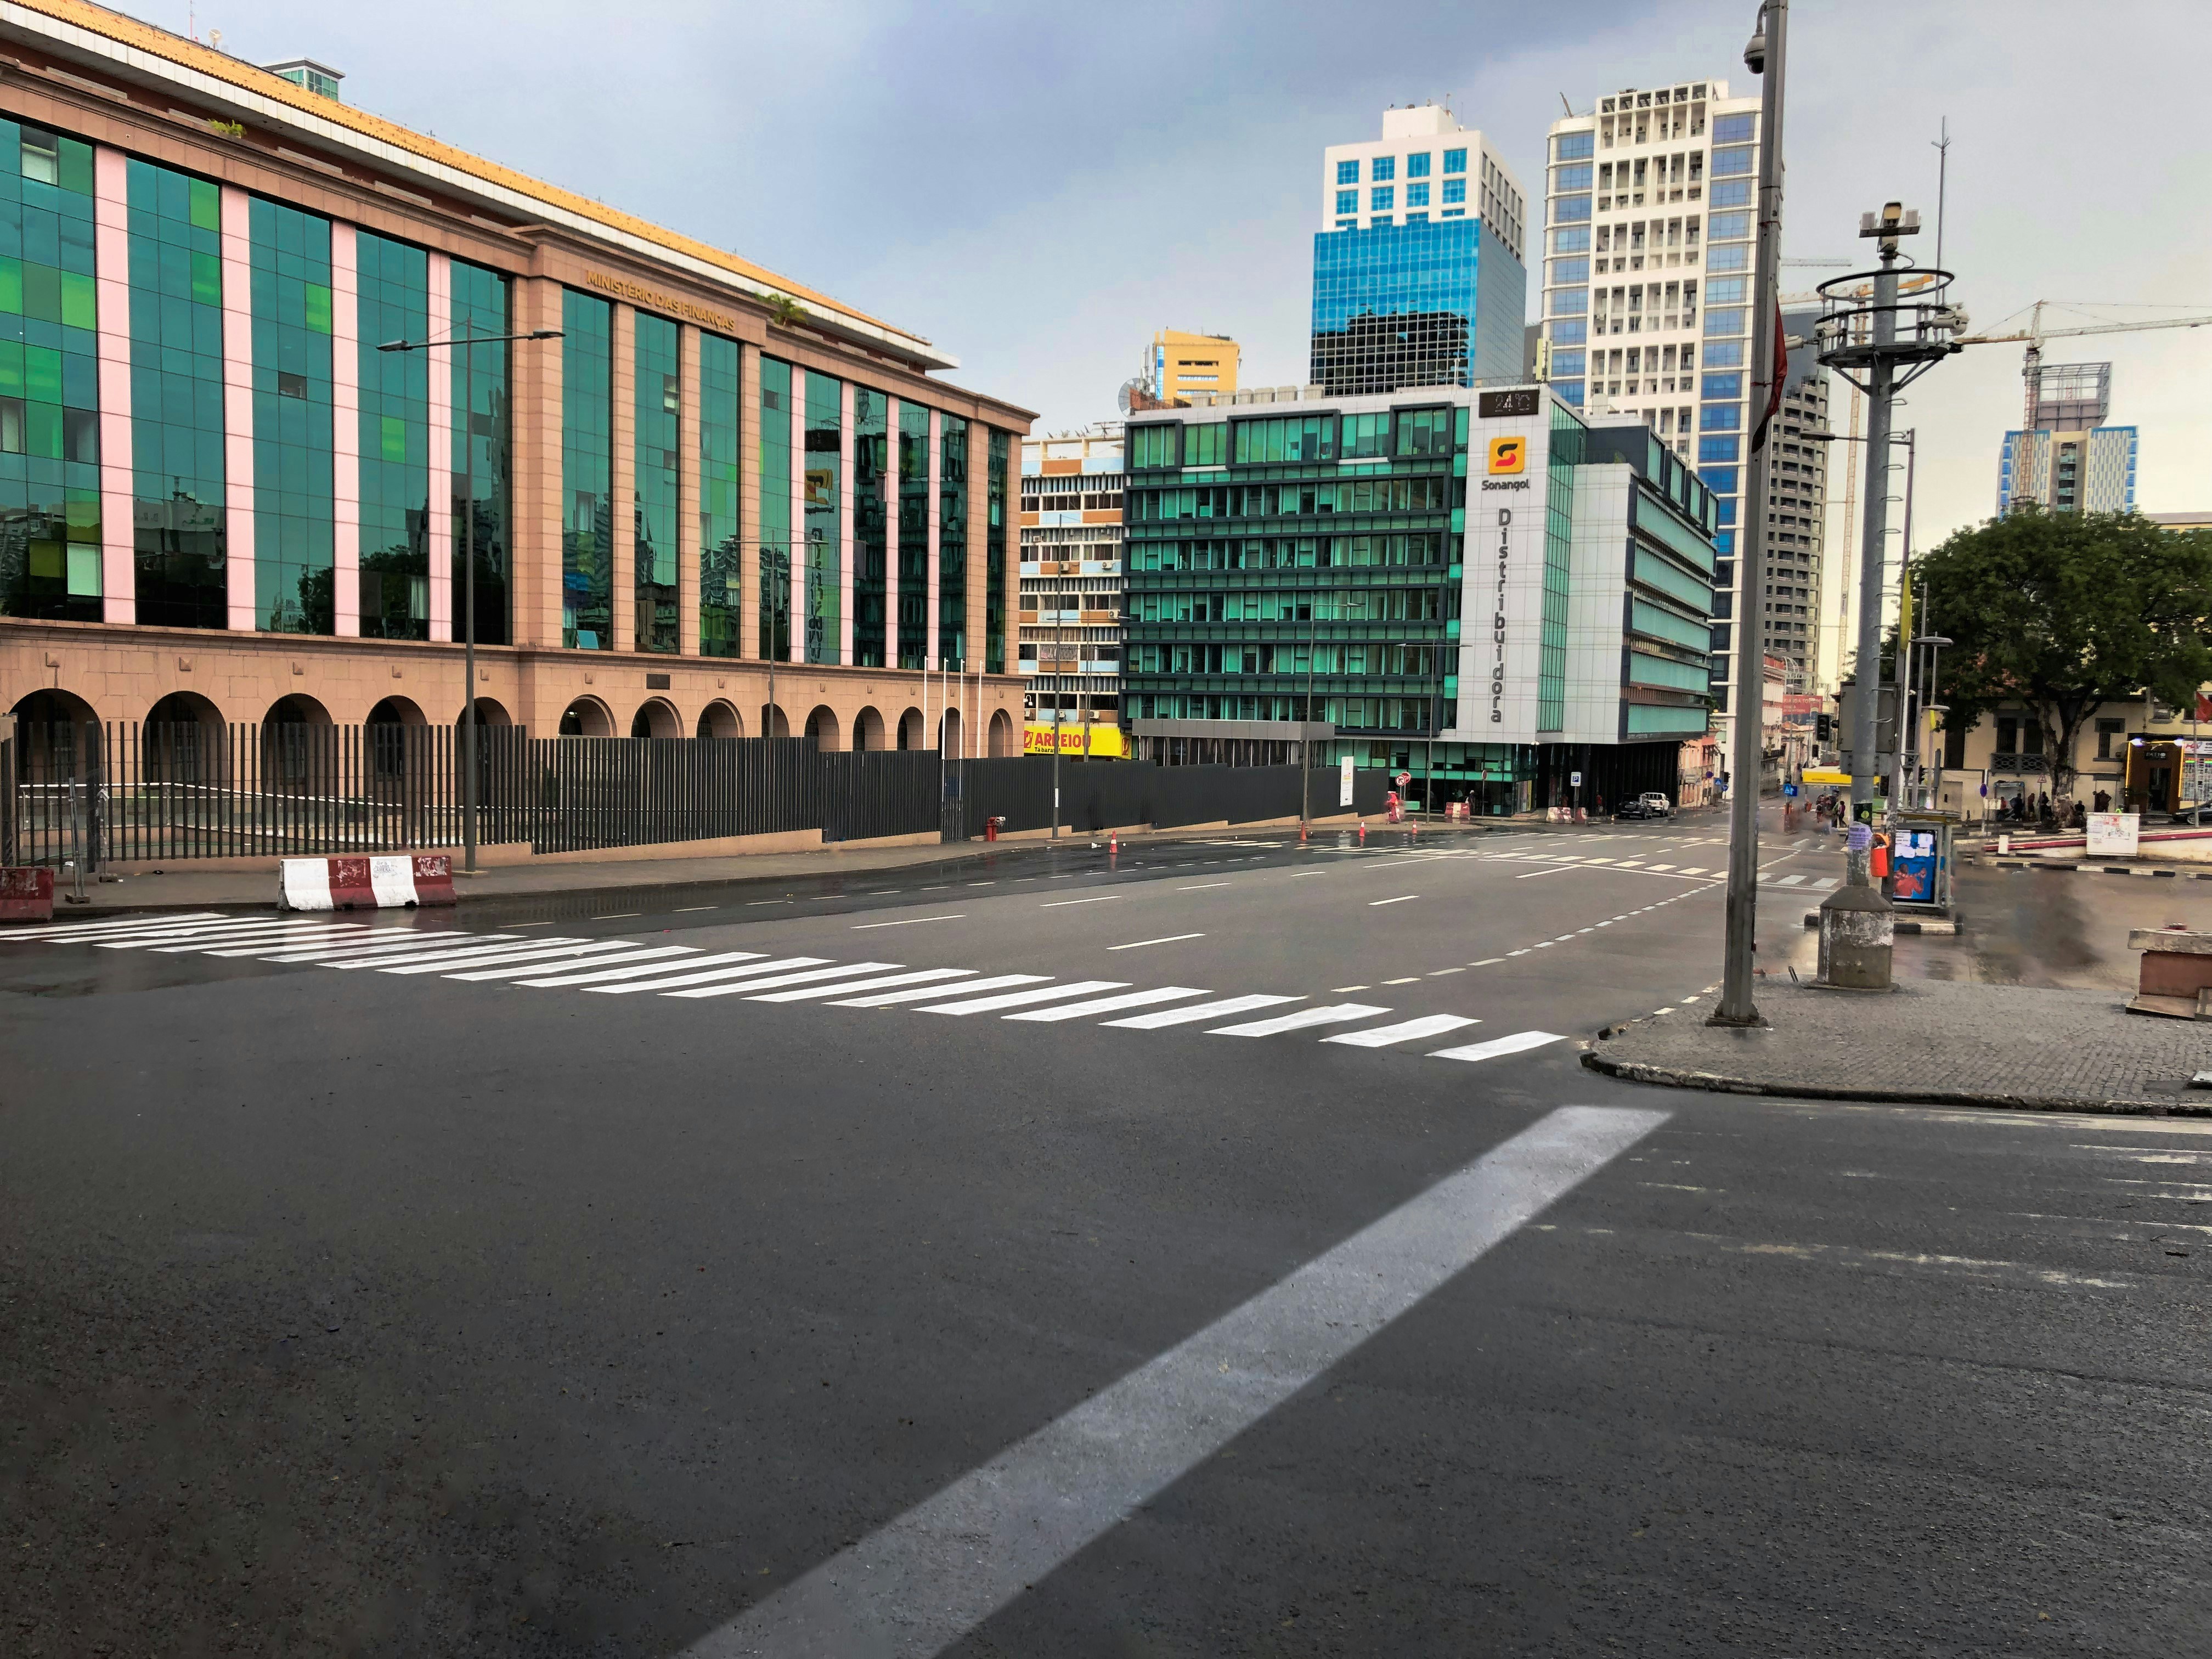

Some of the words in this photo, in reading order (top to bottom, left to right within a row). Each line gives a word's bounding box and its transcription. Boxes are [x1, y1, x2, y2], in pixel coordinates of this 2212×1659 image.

[586, 270, 654, 304] MINISTÉRIO
[654, 294, 680, 313] DAS
[681, 303, 735, 331] FINANÇAS
[1481, 478, 1530, 492] Sonangol
[1491, 508, 1511, 723] Distribuidora
